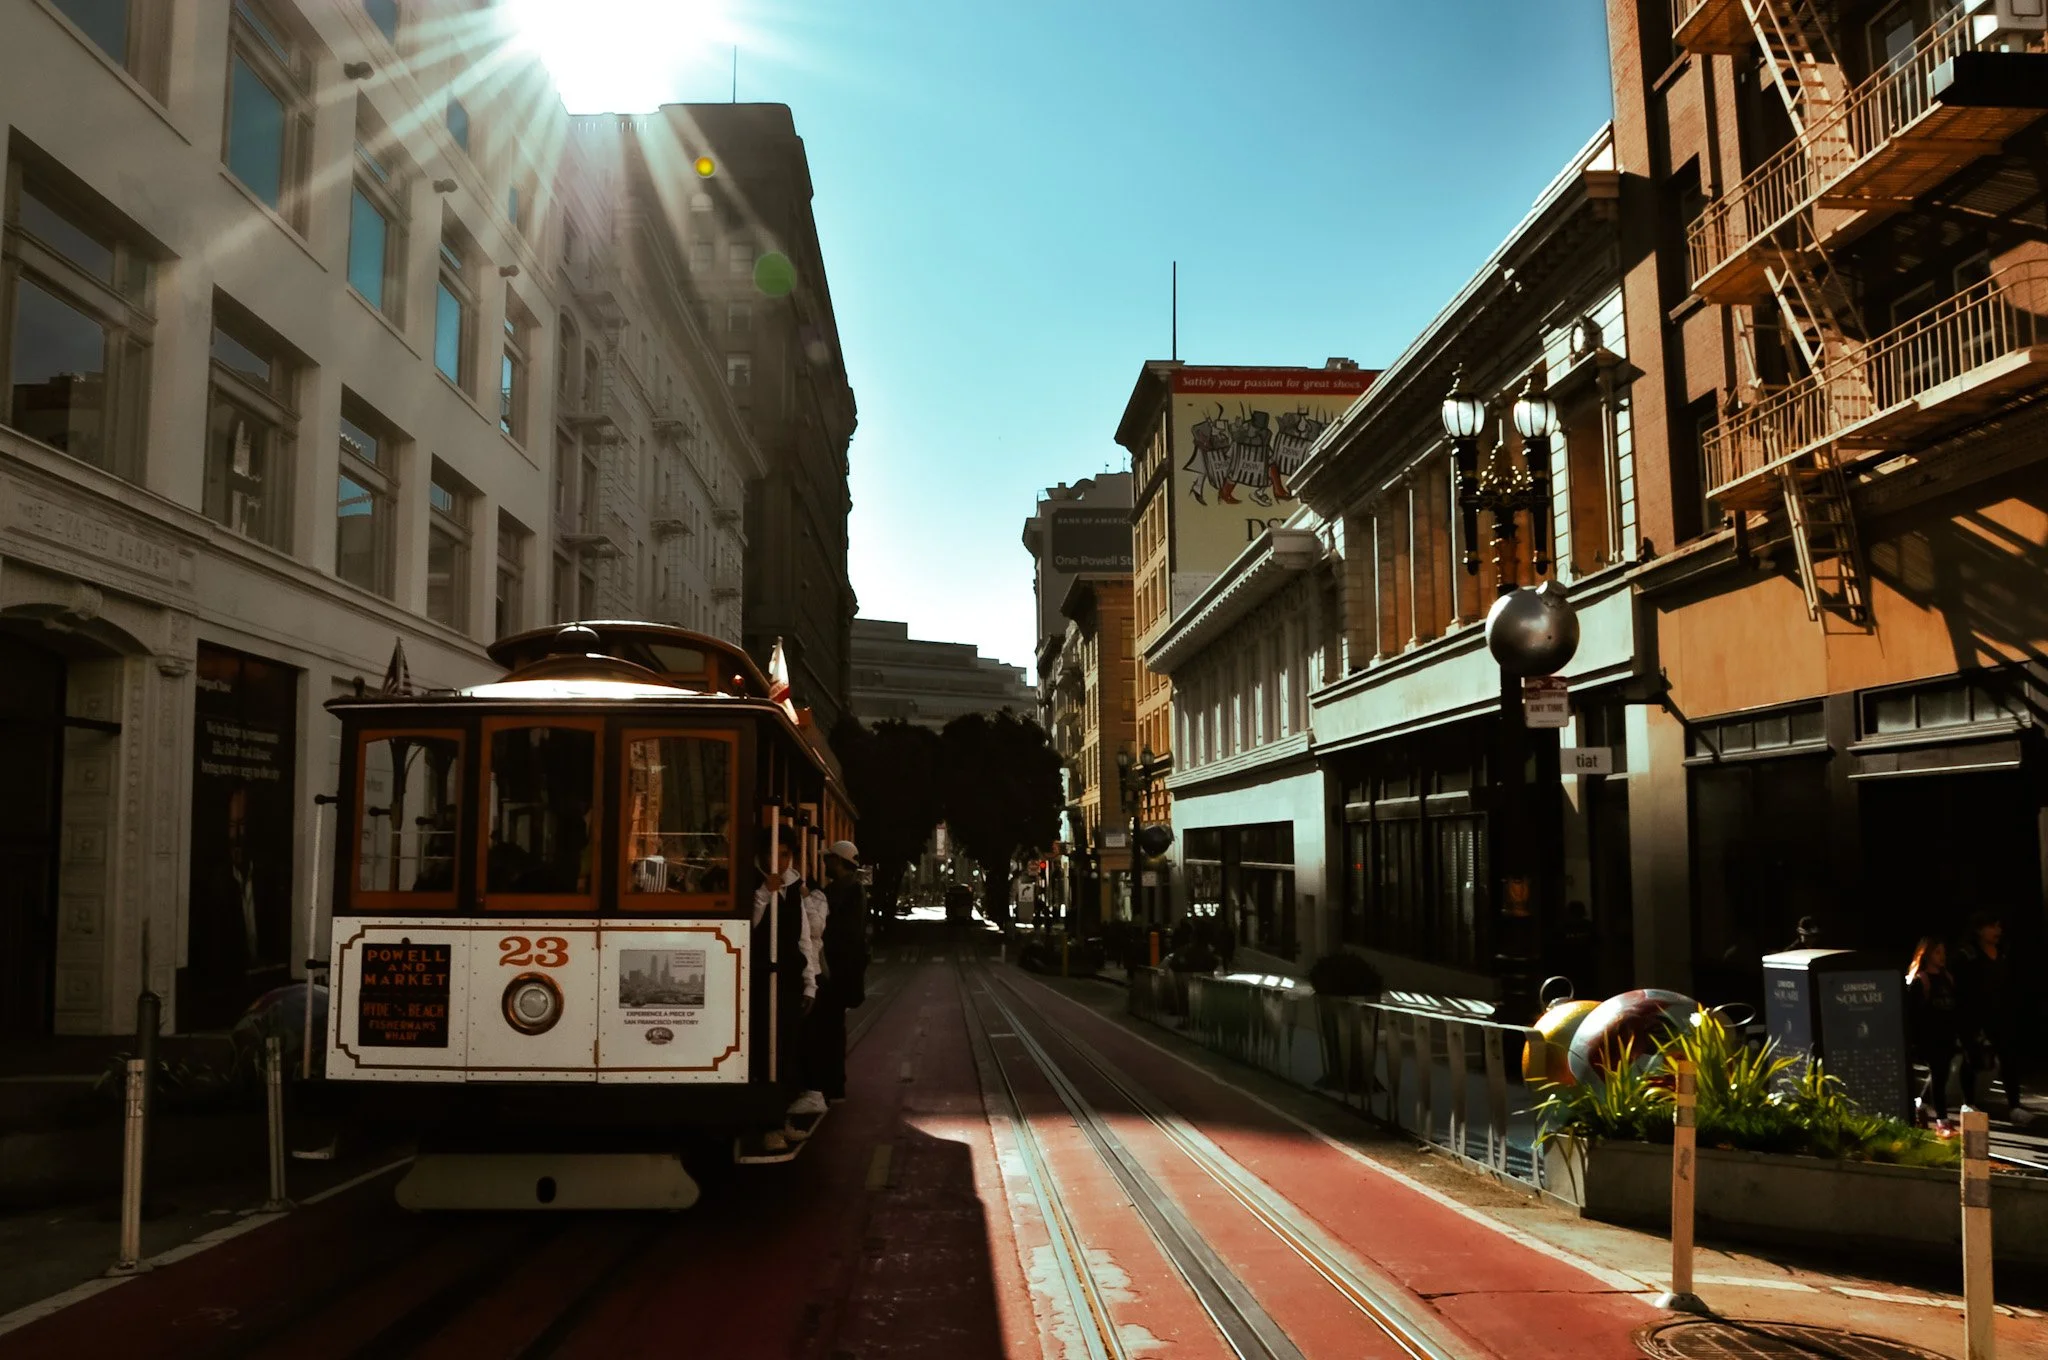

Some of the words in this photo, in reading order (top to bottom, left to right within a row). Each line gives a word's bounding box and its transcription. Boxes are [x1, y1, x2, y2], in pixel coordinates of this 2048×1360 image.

[1182, 377, 1216, 388] Satisfy
[1219, 379, 1240, 388] your
[1244, 378, 1282, 389] passion
[1286, 377, 1300, 388] for
[1303, 379, 1329, 390] great
[1333, 378, 1362, 389] shoes.
[1057, 517, 1080, 525] BANK
[1082, 517, 1093, 525] OF
[1055, 554, 1079, 566] One
[1081, 554, 1118, 567] Powell
[1530, 704, 1545, 712] ANY
[1547, 704, 1563, 712] TIME
[1576, 754, 1598, 767] tiat
[367, 949, 446, 963] POWELL
[499, 936, 569, 968] 23
[387, 962, 426, 972] AND
[364, 973, 447, 986] MARKET
[1777, 980, 1795, 988] UNION
[1843, 982, 1876, 992] UNION
[408, 1003, 444, 1018] BEACH
